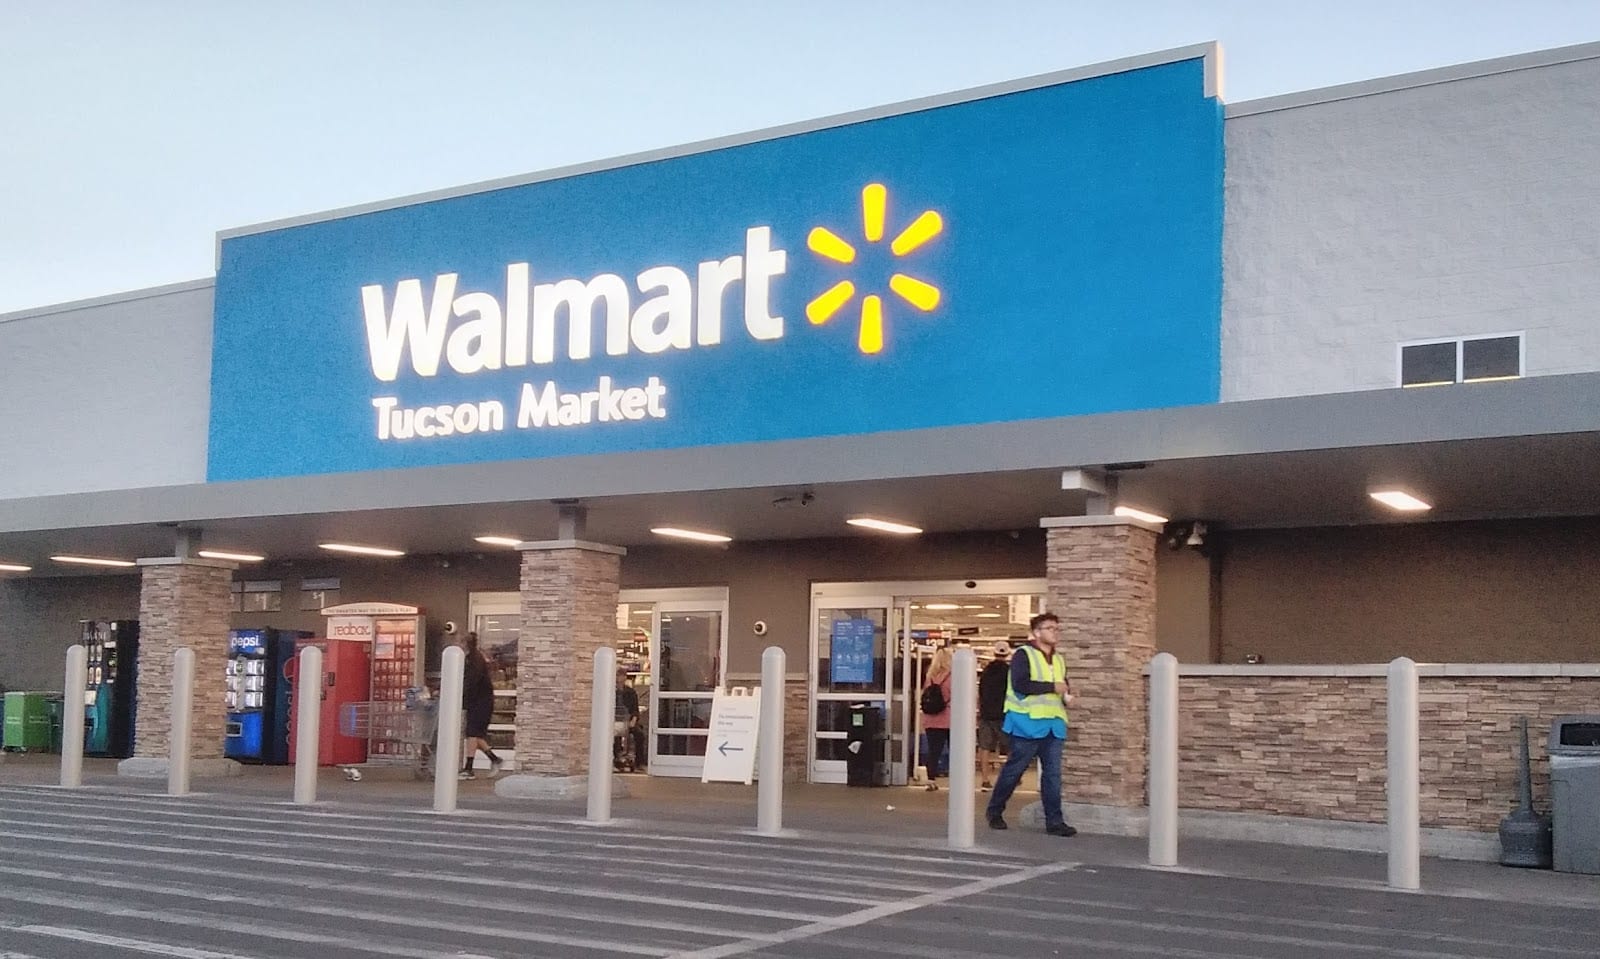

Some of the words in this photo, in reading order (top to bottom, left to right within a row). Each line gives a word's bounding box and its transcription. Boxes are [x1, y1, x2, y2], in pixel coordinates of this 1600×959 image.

[361, 226, 787, 382] Walmart
[371, 396, 504, 440] Tucson
[517, 375, 667, 429] Market
[230, 635, 260, 649] pepsi
